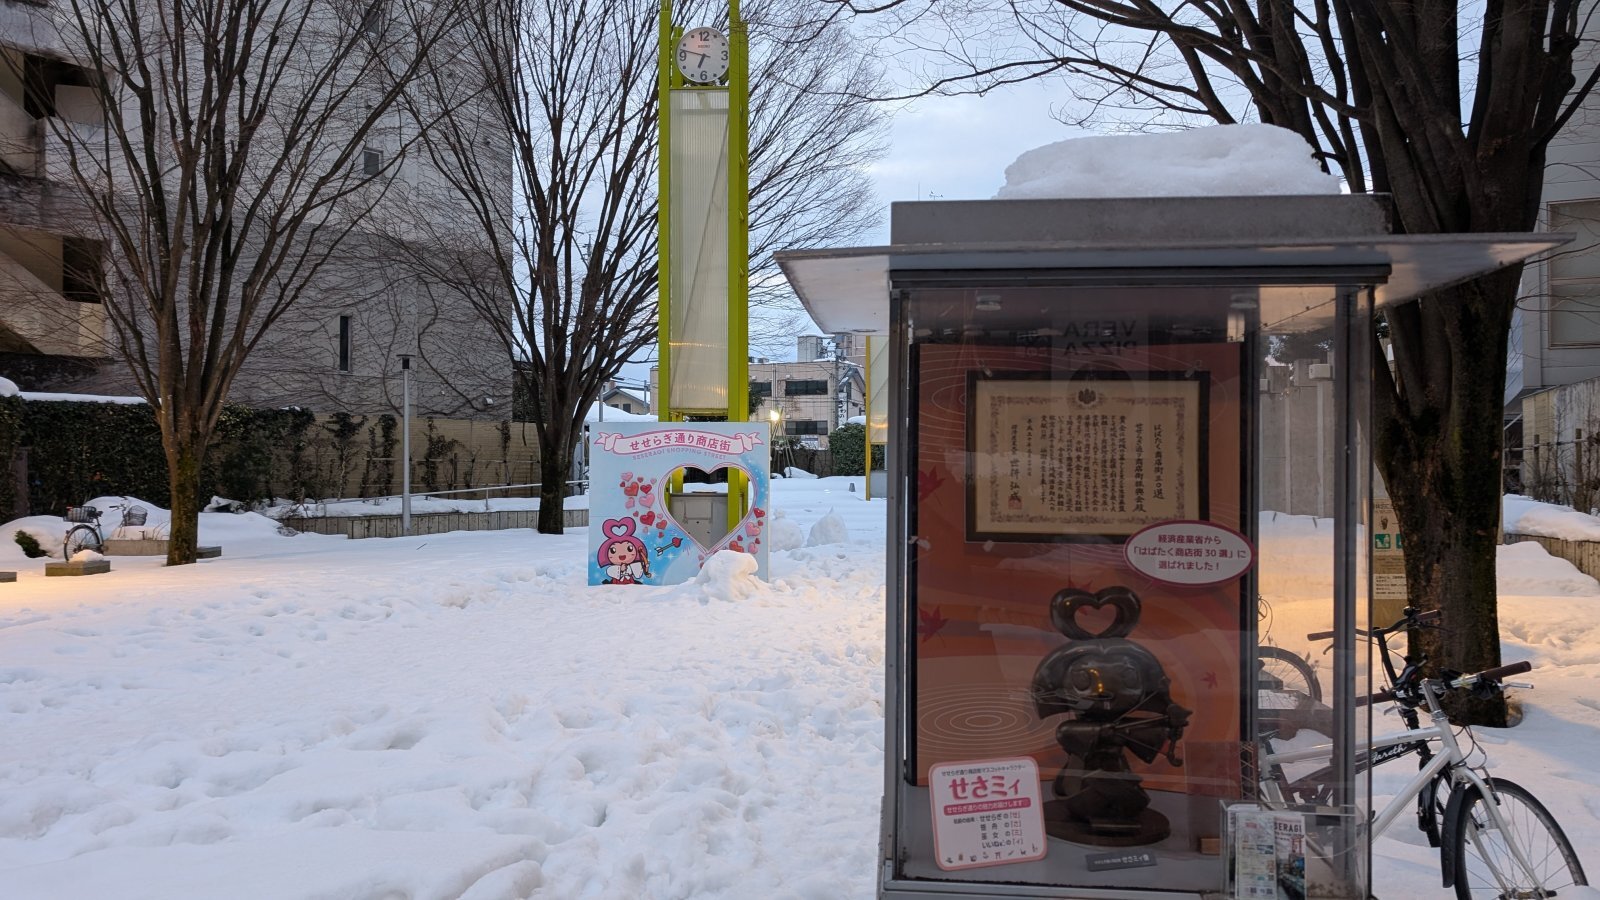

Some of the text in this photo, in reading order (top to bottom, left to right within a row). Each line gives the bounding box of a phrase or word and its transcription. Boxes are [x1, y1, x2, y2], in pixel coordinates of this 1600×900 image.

[699, 31, 710, 42] 12
[679, 50, 687, 61] 9
[721, 50, 728, 61] 3
[700, 70, 708, 81] 6
[630, 432, 732, 452] せせらぎ通り商店街
[632, 447, 726, 460] SESERAGI SHOPPING STREET
[1158, 534, 1222, 545] 経済産業省から
